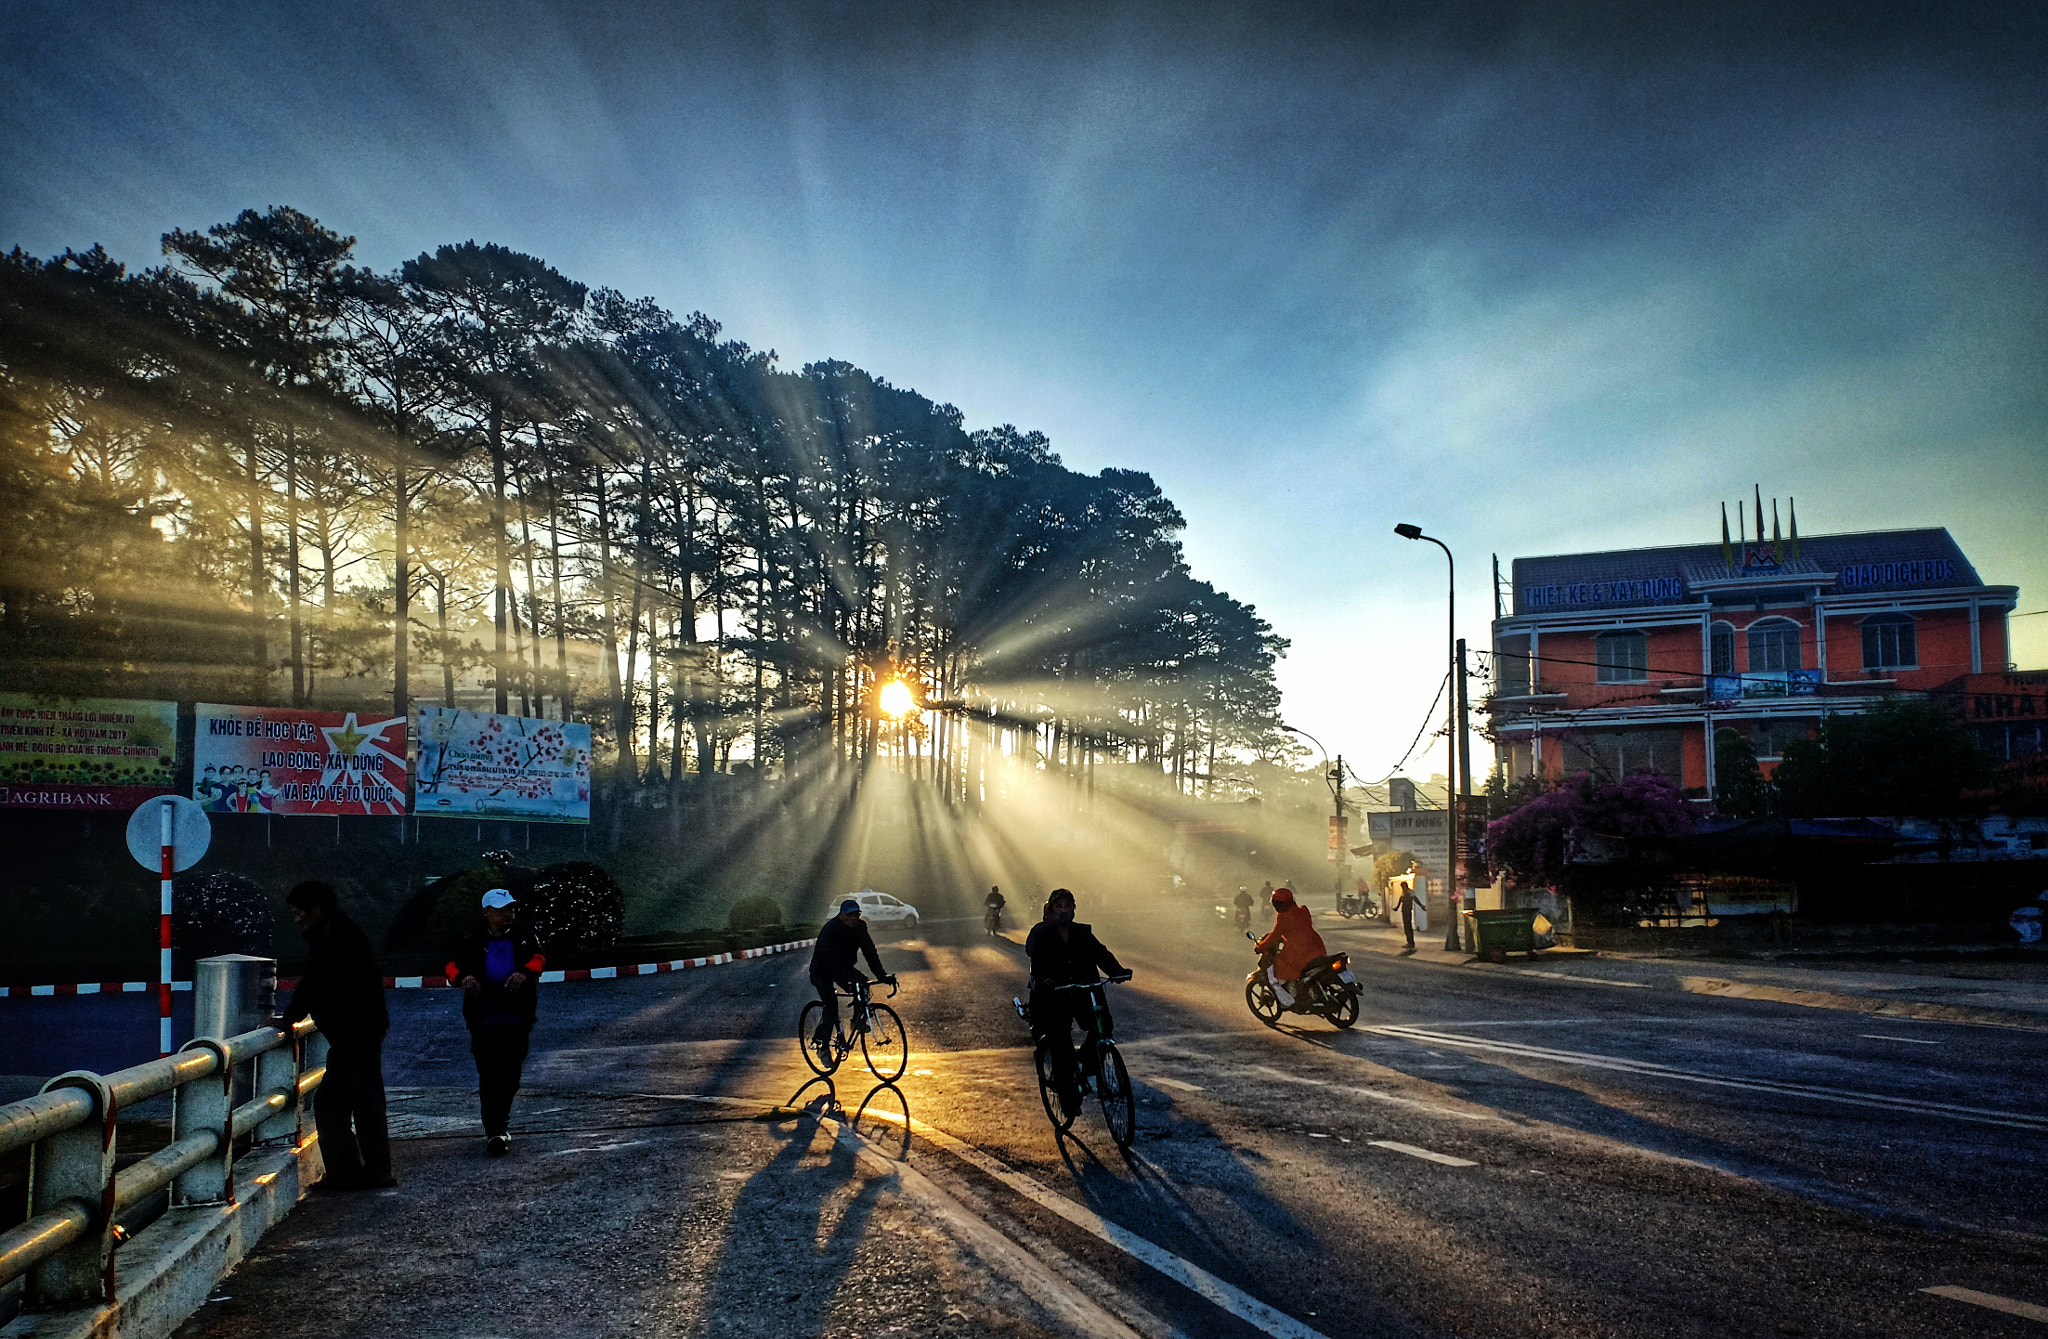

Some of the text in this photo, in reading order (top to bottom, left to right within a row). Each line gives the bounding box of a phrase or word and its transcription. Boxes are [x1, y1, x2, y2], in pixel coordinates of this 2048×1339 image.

[1844, 566, 1880, 586] GIAO
[1592, 584, 1602, 603] &
[210, 714, 317, 744] KHỎE ĐỂ HỌC TẬP,
[262, 751, 284, 767] LAO
[287, 749, 323, 773] ĐỘNG,
[327, 752, 349, 770] XÂY
[11, 791, 112, 806] AGRIBANK
[283, 779, 394, 806] VÀ BẢO VỆ TỔ QUỐC
